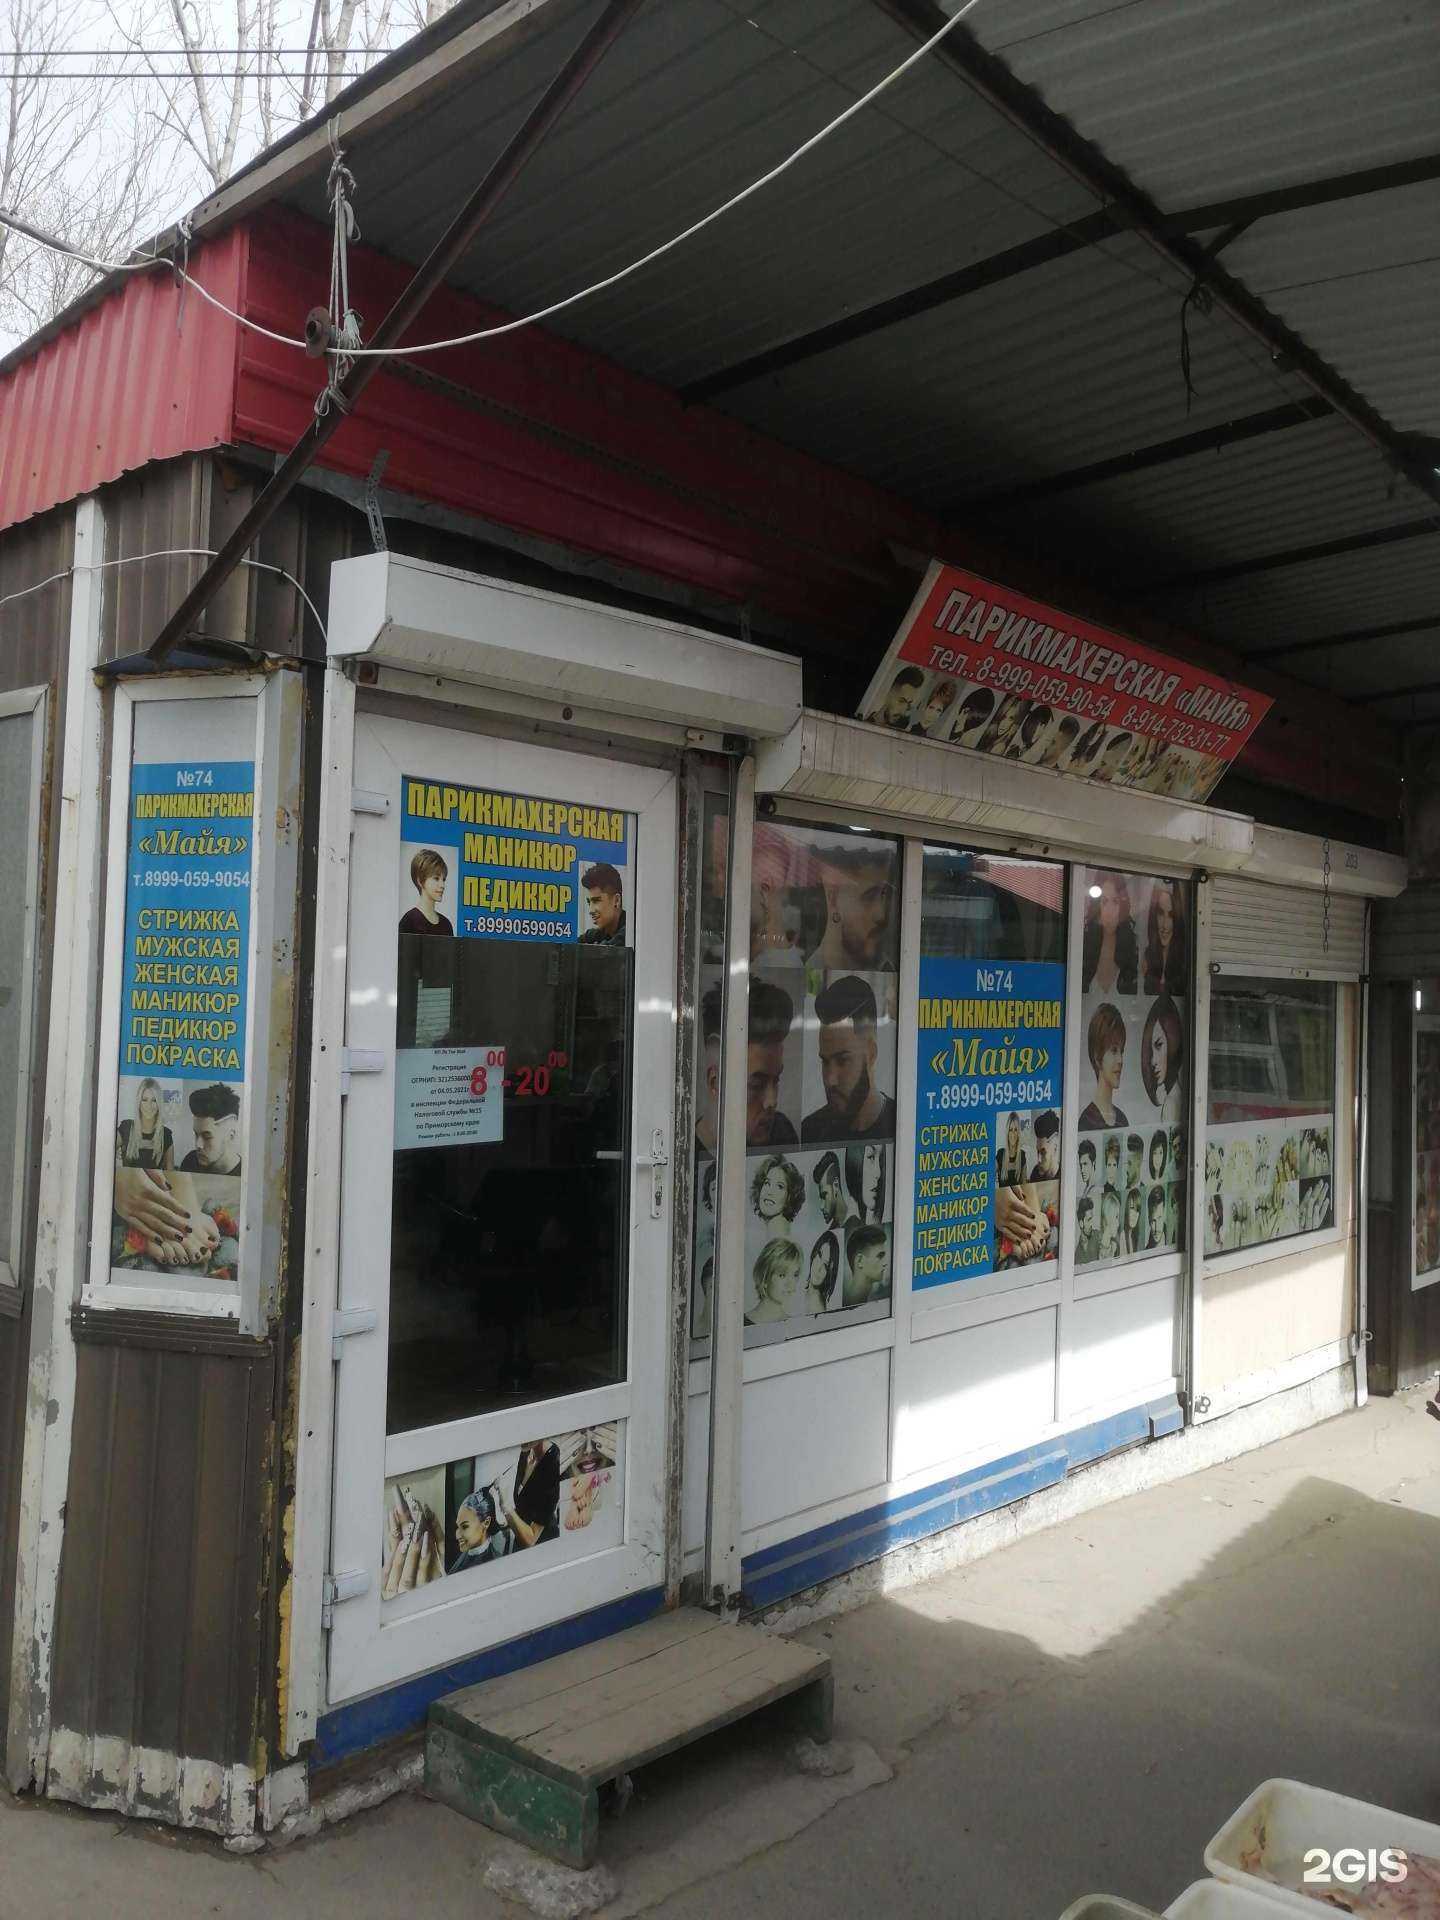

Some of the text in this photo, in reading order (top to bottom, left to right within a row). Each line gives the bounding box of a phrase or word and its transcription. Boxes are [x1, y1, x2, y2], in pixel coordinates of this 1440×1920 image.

[934, 588, 1251, 731] ПАРИКМАХЕРСКАЯ «МАЙЯ»
[1121, 705, 1232, 754] 8-914-732-31-77
[176, 770, 213, 787] №74
[136, 792, 254, 818] ПАРИКМАХЕРСКАЯ
[407, 782, 625, 843] ПАРИКМАХЕРСКАЯ
[138, 828, 248, 856] «Майя»
[463, 831, 577, 874] МАНИКЮР
[133, 870, 250, 888] т.8999-059-9054
[463, 876, 572, 914] ПЕДИКЮР
[138, 909, 240, 931] СТРИЖКА
[464, 916, 572, 938] т.89990599054
[135, 936, 240, 959] МУЖСКАЯ
[134, 963, 239, 986] ЖЕНСКАЯ
[976, 968, 1014, 993] №74
[131, 990, 240, 1014] МАНИКЮР
[918, 998, 1061, 1029] ПАРИКМАХЕРСКАЯ
[131, 1016, 237, 1042] ПЕДИКЮР
[126, 1043, 241, 1069] ПОКРАСКА
[931, 1034, 1050, 1078] «Майя»
[926, 1080, 1052, 1110] т.8999-059-9054
[920, 1122, 988, 1146] СТРИЖКА
[919, 1146, 989, 1172] МУЖСКАЯ
[918, 1171, 988, 1198] ЖЕНСКАЯ
[916, 1196, 989, 1224] МАНИКЮР
[917, 1220, 987, 1250] ПЕДИКЮР
[913, 1244, 990, 1277] ПОКРАСКА
